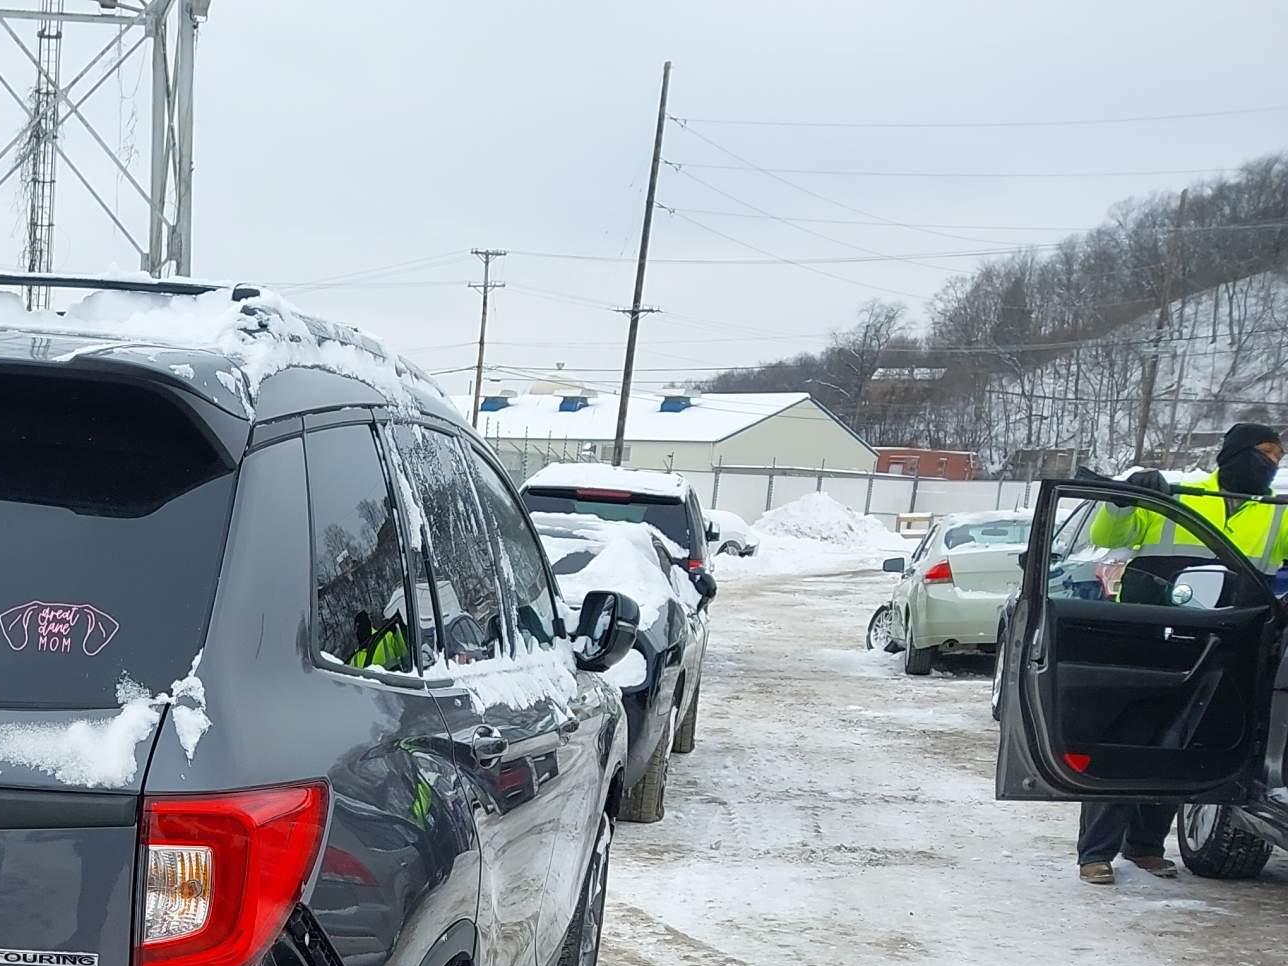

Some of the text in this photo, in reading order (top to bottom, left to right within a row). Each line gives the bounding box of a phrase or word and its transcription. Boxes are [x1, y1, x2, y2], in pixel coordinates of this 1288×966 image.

[38, 607, 79, 626] great
[38, 622, 70, 636] dane
[38, 635, 71, 653] MOM
